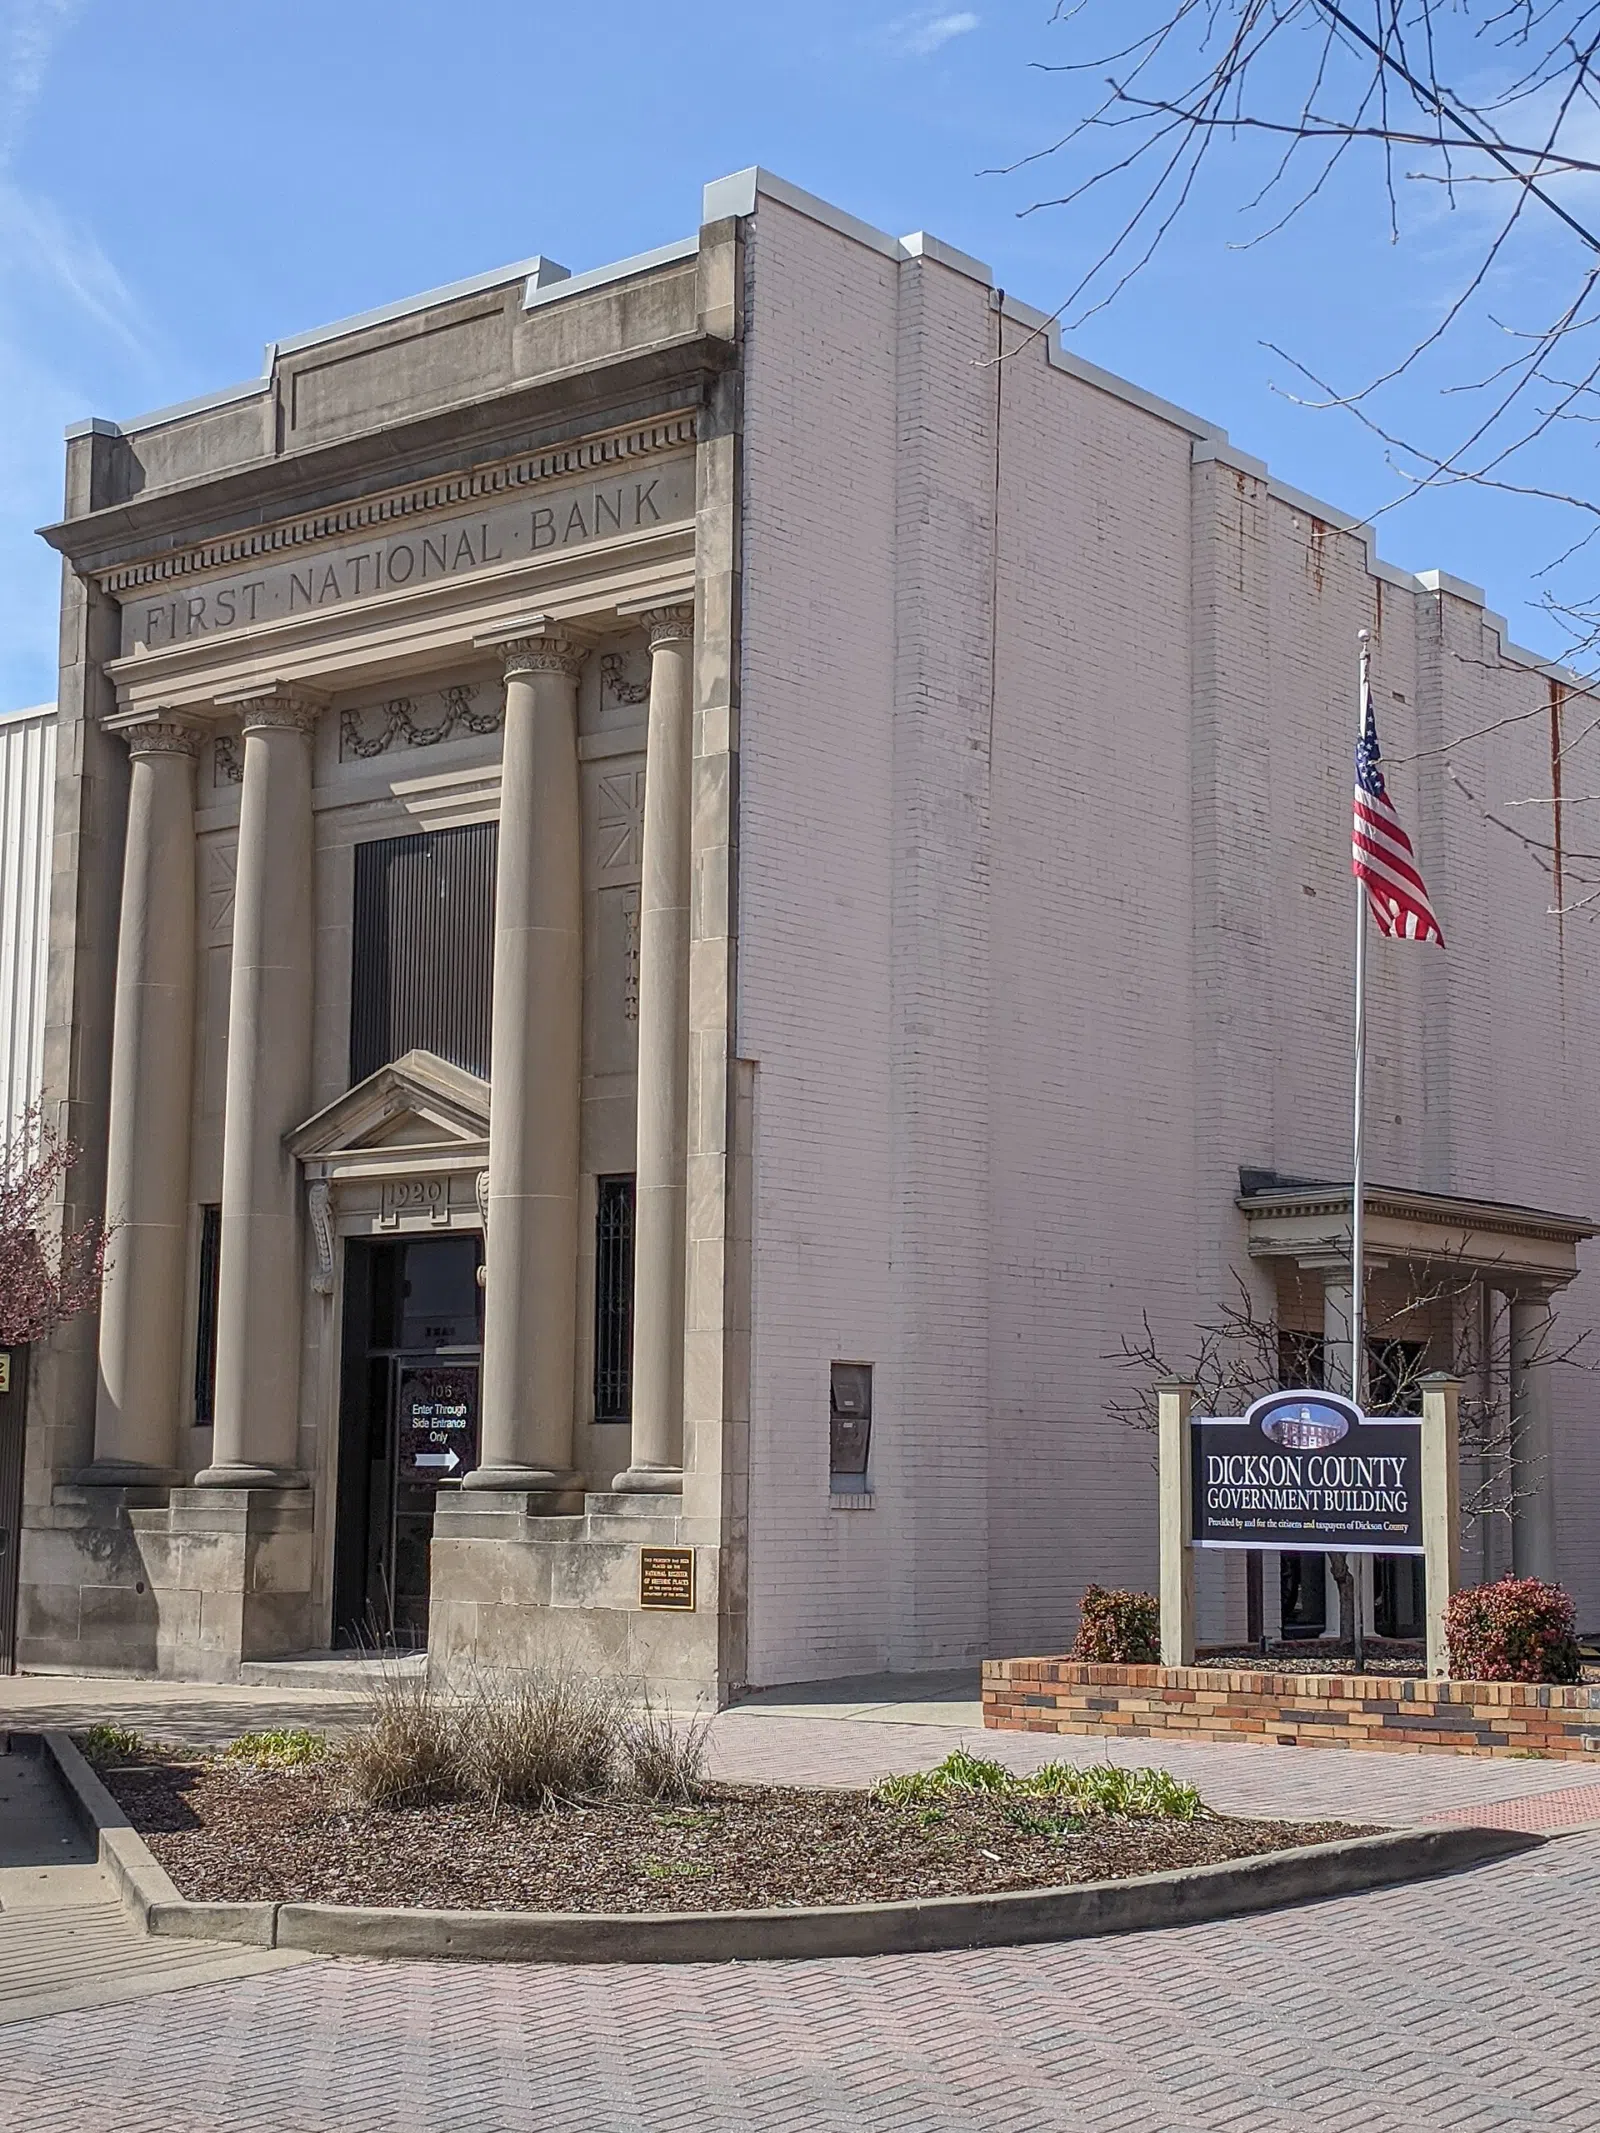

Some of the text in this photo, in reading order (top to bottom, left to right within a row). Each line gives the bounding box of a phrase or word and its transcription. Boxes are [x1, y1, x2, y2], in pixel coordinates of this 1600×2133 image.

[145, 479, 663, 646] FIRST NATIONAL BANK
[388, 1180, 442, 1207] 1920
[431, 1385, 452, 1398] 106
[412, 1403, 467, 1417] Enter Through
[412, 1417, 467, 1428] Side Entrance
[429, 1431, 448, 1444] Only
[1207, 1455, 1407, 1488] DICKSON COUNTY
[1207, 1487, 1409, 1513] GOVERNMENT BUILDING
[1208, 1517, 1235, 1527] Provided
[1235, 1517, 1243, 1529] by
[1244, 1518, 1255, 1527] and
[1256, 1518, 1266, 1527] for
[1267, 1519, 1277, 1528] the
[1278, 1519, 1302, 1528] citizens
[1303, 1519, 1315, 1529] and
[1346, 1520, 1355, 1530] of
[1355, 1520, 1382, 1530] Dickson
[1383, 1521, 1409, 1533] County
